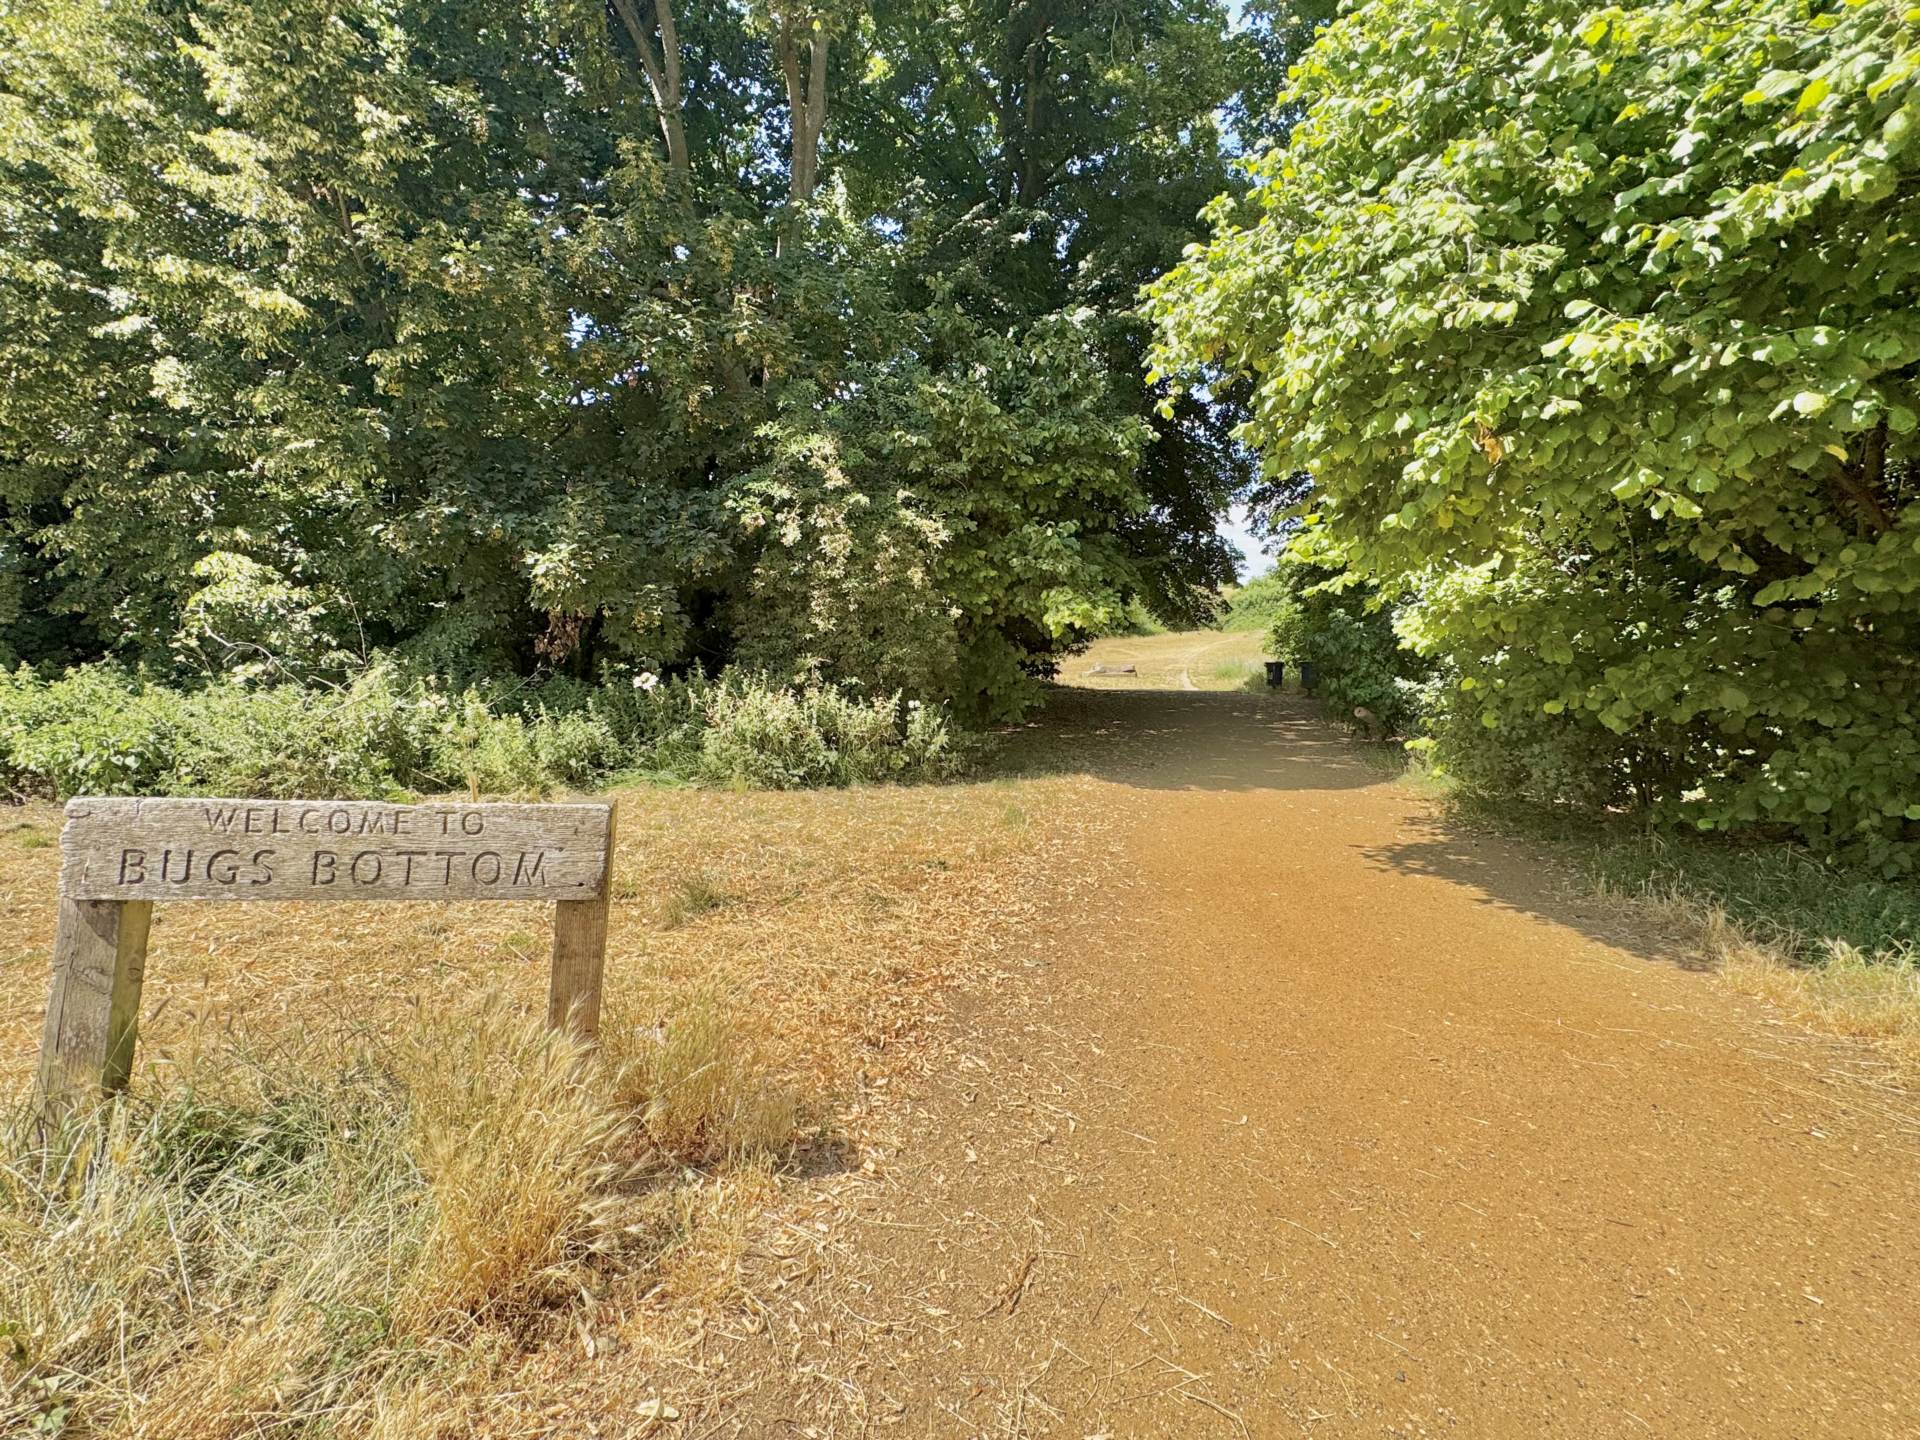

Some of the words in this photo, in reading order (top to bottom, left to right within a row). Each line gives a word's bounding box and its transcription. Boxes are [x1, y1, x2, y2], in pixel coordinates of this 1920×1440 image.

[205, 808, 411, 835] WELCOME
[435, 810, 485, 836] TO
[118, 848, 276, 886] BUGS
[312, 850, 548, 887] BOTTOM
